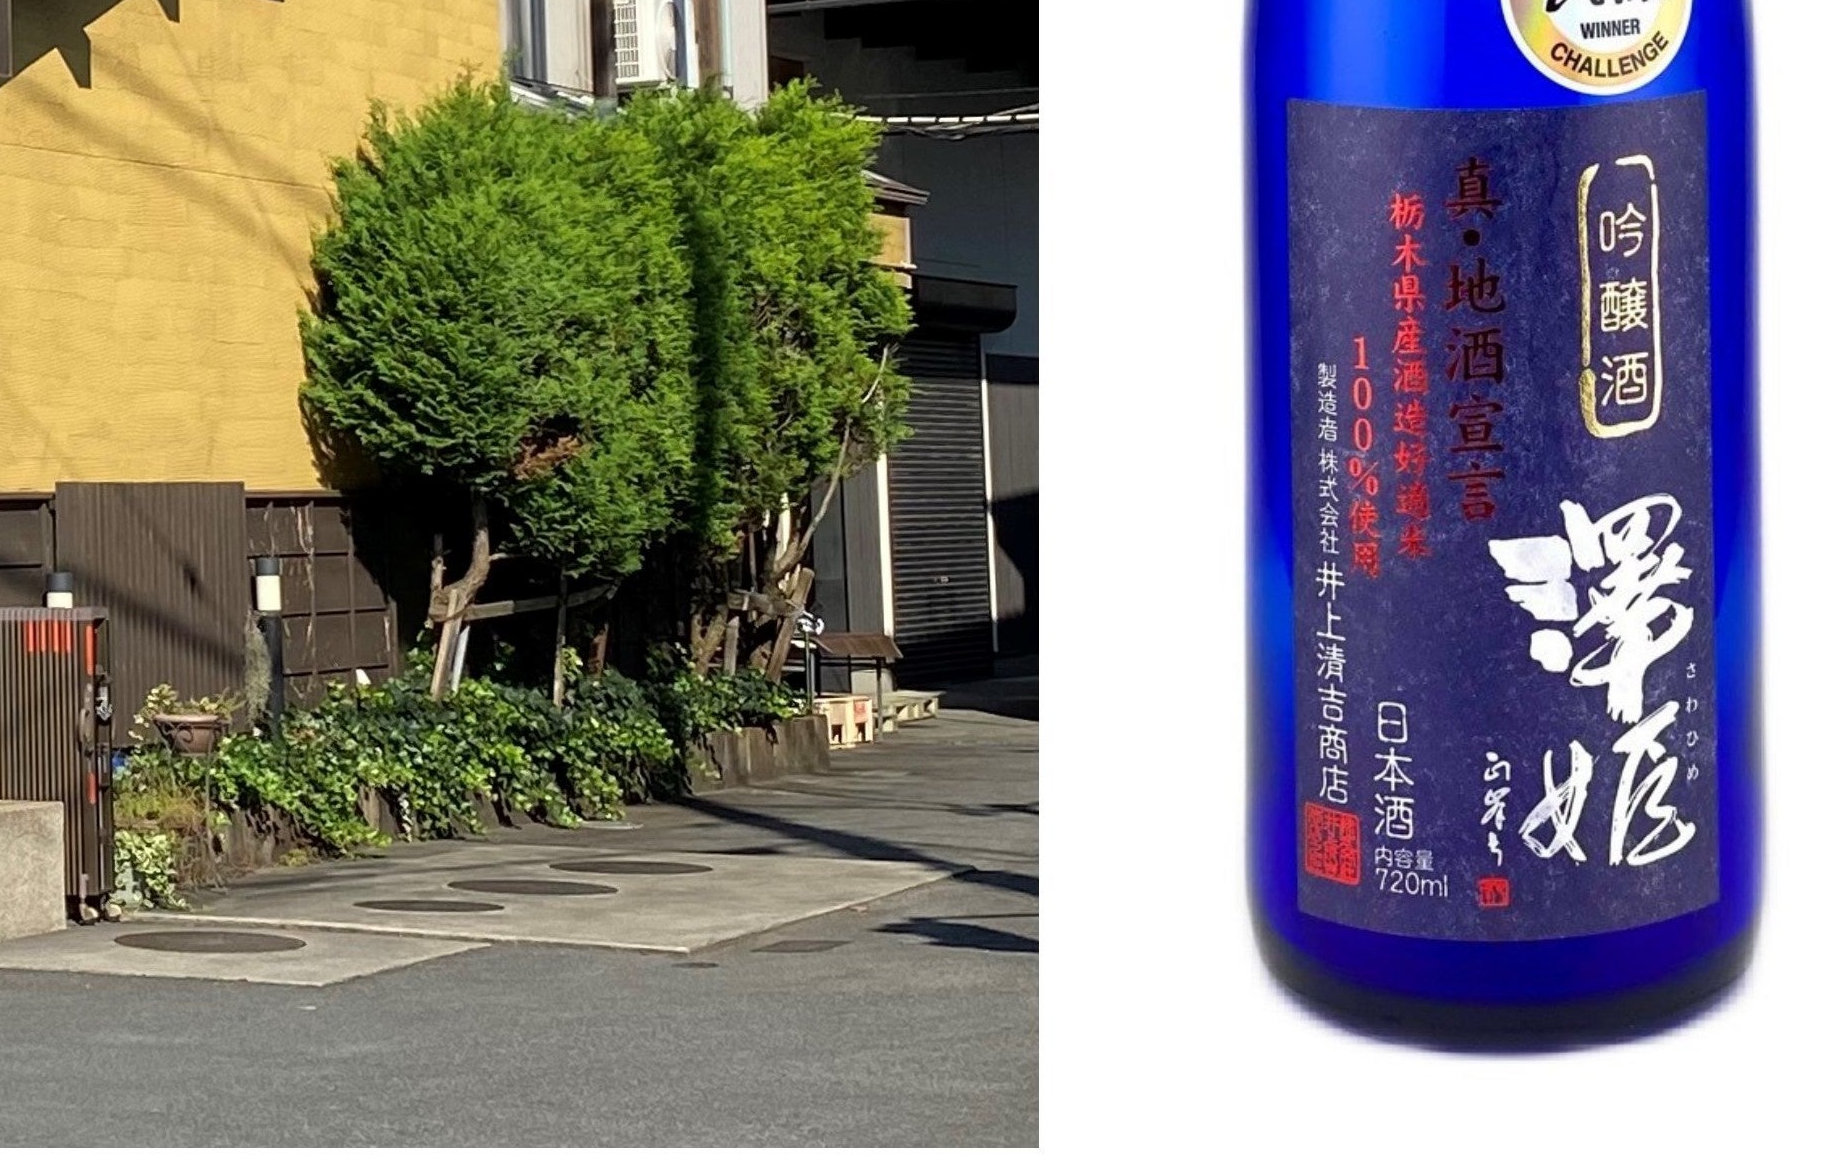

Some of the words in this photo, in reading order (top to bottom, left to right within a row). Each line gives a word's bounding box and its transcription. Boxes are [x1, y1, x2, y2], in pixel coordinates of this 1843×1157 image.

[1549, 30, 1669, 78] CHALLENGE
[1579, 17, 1641, 40] WINNER
[1598, 201, 1650, 407] 吟醸酒
[1389, 191, 1432, 560] 栃木県産酒造好適米
[1684, 661, 1700, 782] さわひめ
[1373, 701, 1415, 841] 日本酒
[1373, 843, 1436, 872] 内容量
[1375, 868, 1450, 898] 720ml
